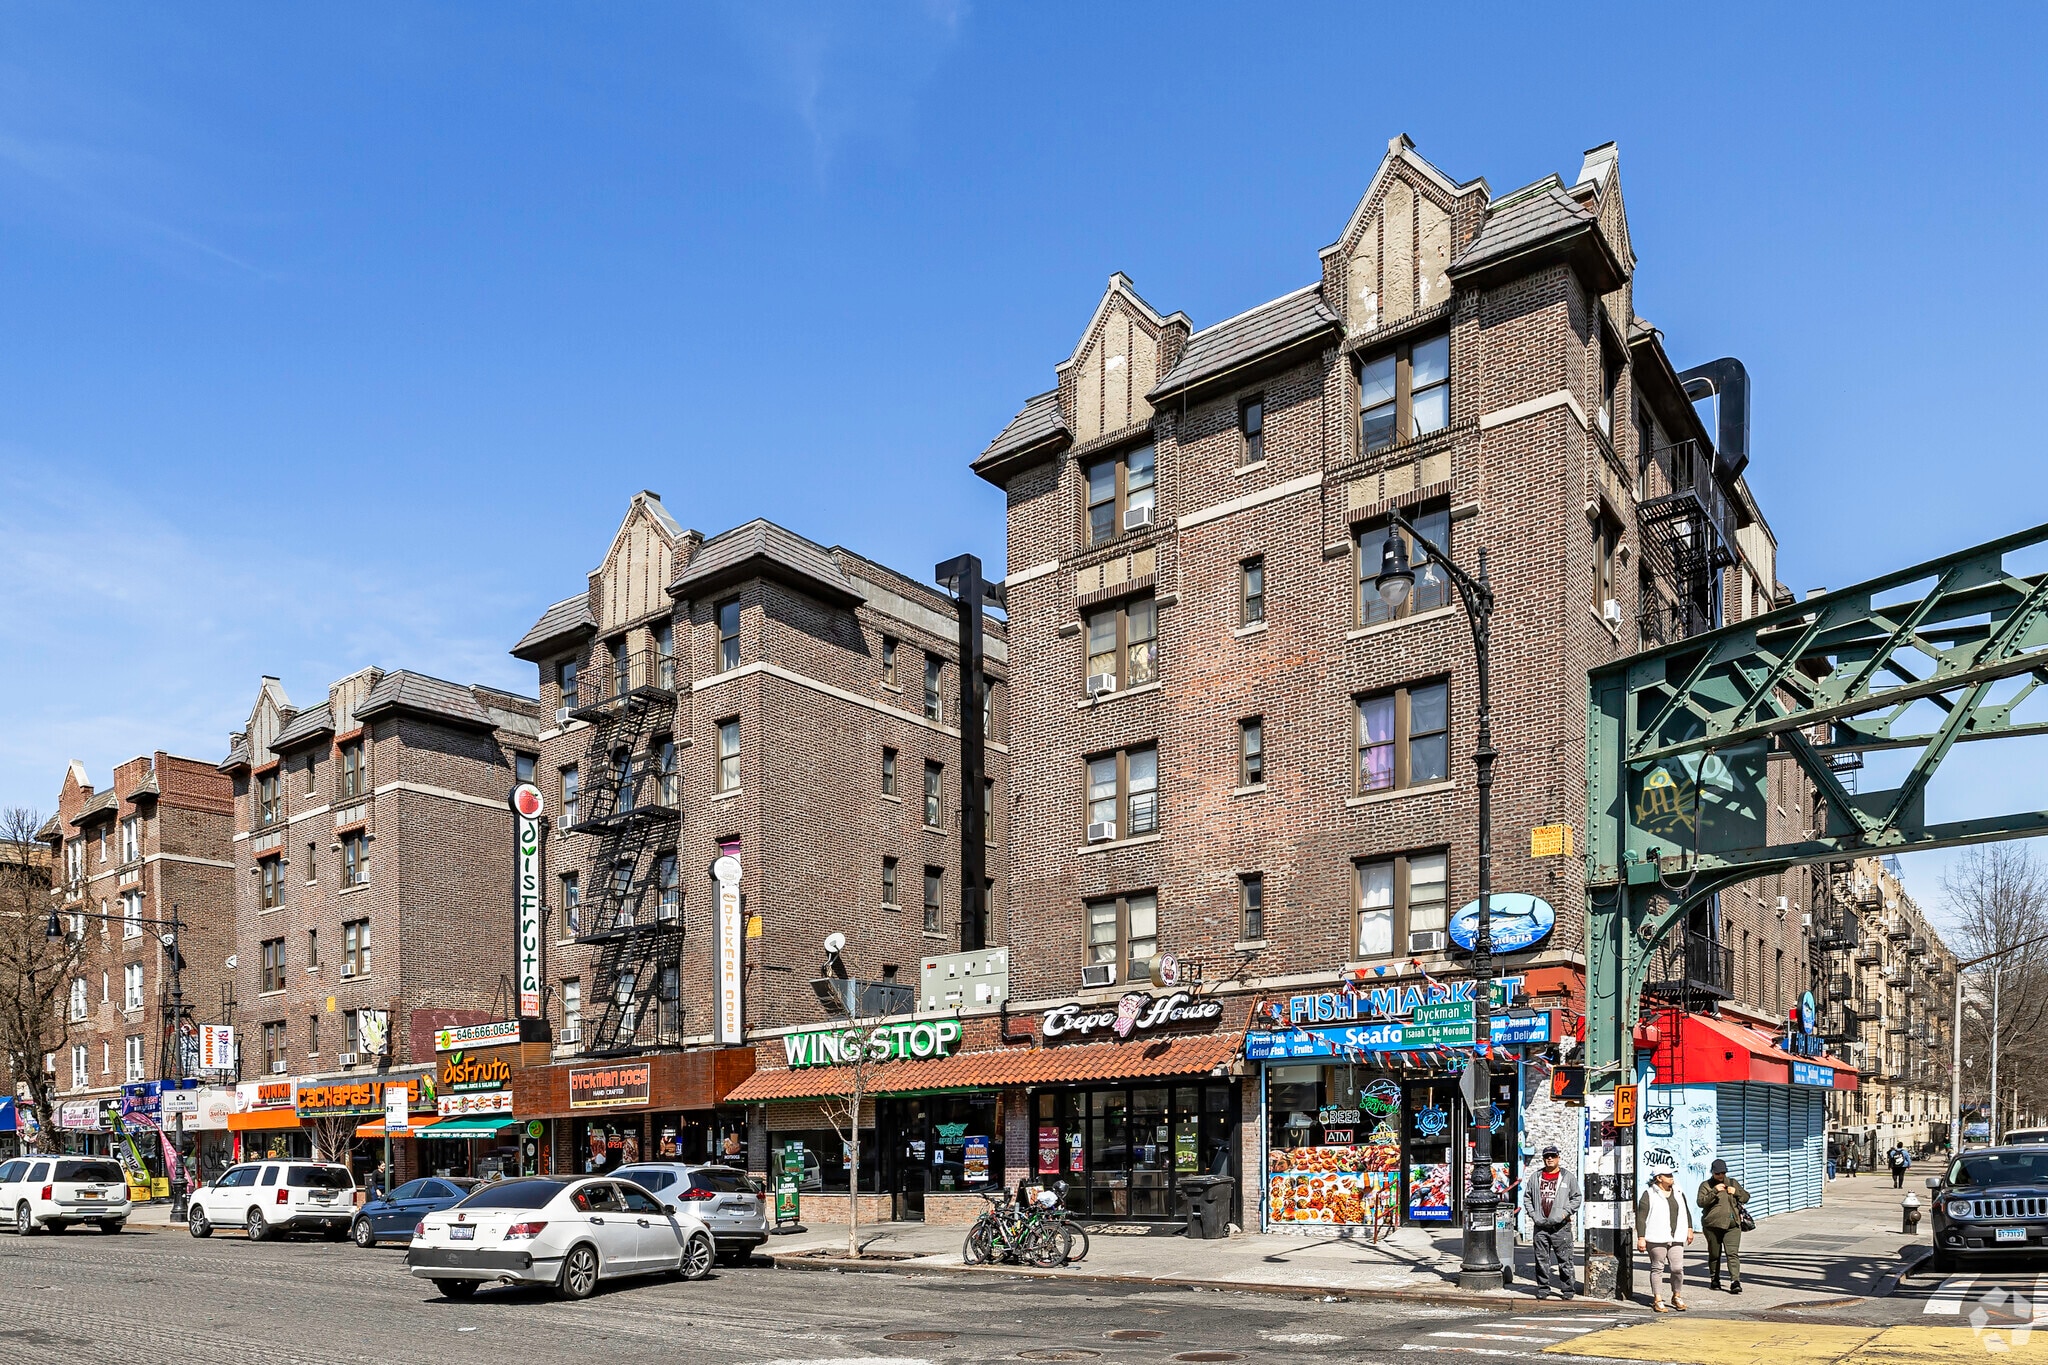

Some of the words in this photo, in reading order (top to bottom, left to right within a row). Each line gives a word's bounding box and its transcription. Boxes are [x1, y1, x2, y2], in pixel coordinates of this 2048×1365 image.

[1290, 992, 1357, 1023] FISH
[1371, 976, 1525, 1016] MARKT
[725, 990, 735, 1032] DOGS
[1043, 1004, 1116, 1036] Crepe
[1136, 994, 1218, 1028] House
[1417, 1007, 1459, 1023] Dyckman
[1463, 1003, 1470, 1012] St
[1271, 1034, 1286, 1044] Fish
[1345, 1026, 1403, 1046] Seafo
[1405, 1028, 1426, 1039] Isaiah
[1427, 1026, 1440, 1037] Ché
[1442, 1025, 1470, 1036] Moronta
[1494, 1031, 1511, 1042] Free
[1513, 1030, 1546, 1041] Delivery
[1252, 1047, 1269, 1057] Fried
[1270, 1046, 1285, 1056] Fish
[1293, 1044, 1314, 1054] Fruits
[443, 1056, 511, 1083] disFruta
[619, 1068, 648, 1086] DOGS
[372, 1082, 382, 1105] Y
[606, 1088, 625, 1096] CRAFTED
[1359, 1100, 1399, 1114] Seafood
[1622, 1107, 1631, 1120] P
[1329, 1110, 1361, 1124] BEER
[1073, 1135, 1080, 1144] A
[1327, 1131, 1351, 1142] ATM
[936, 1151, 942, 1160] A
